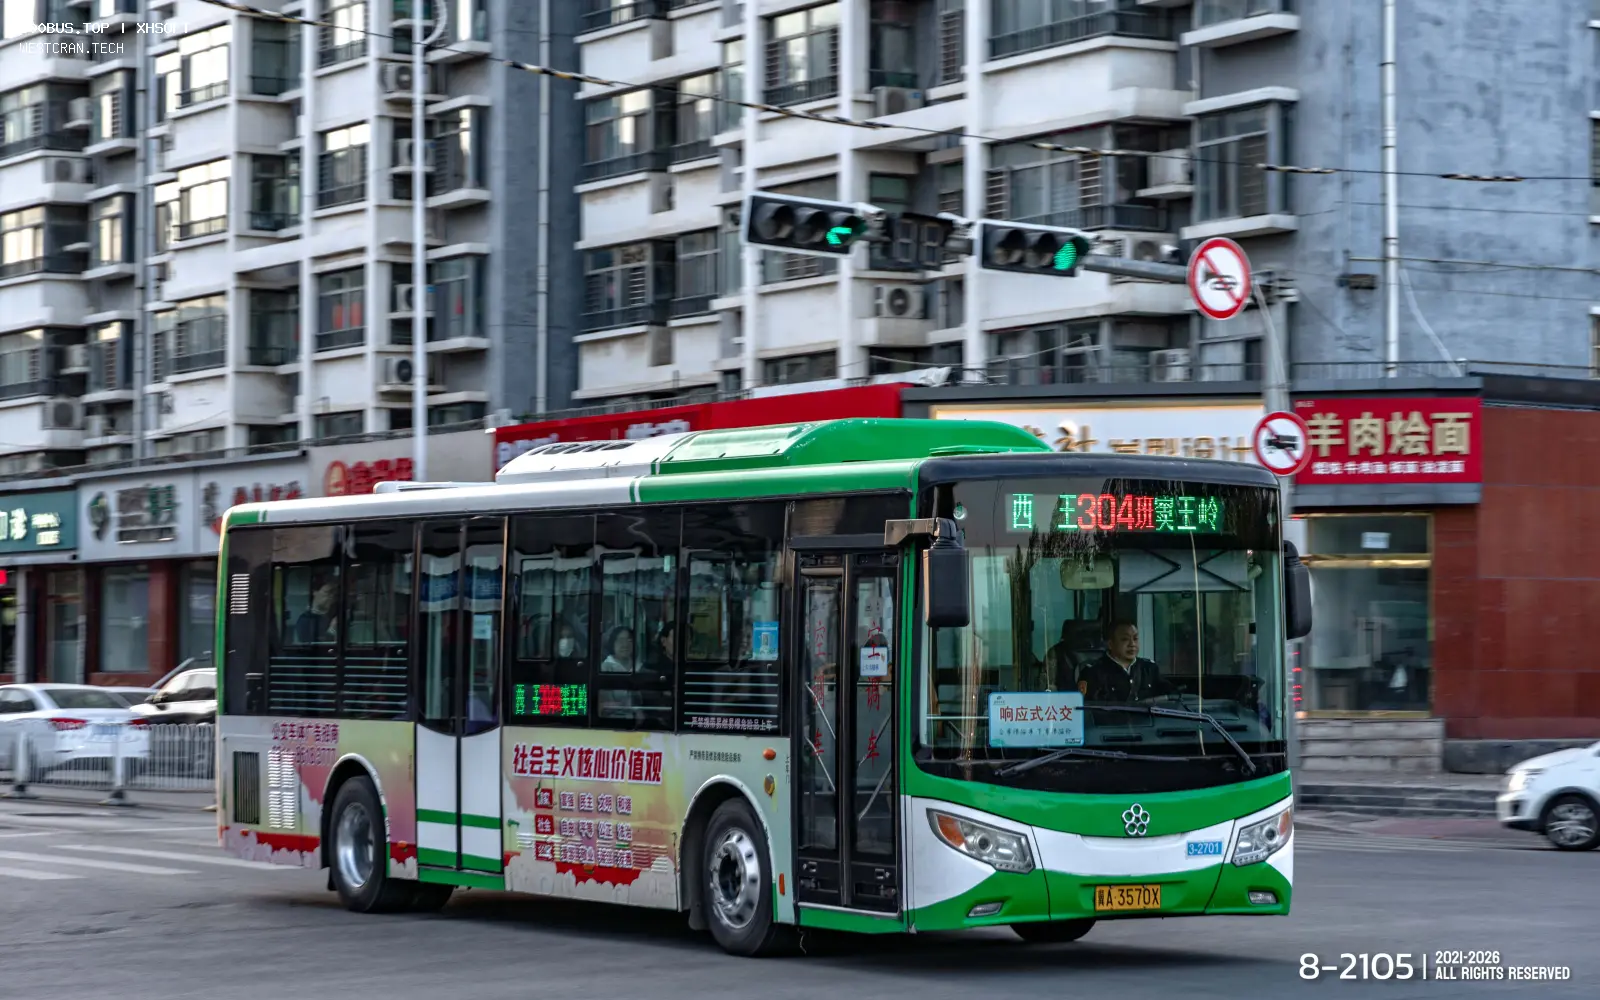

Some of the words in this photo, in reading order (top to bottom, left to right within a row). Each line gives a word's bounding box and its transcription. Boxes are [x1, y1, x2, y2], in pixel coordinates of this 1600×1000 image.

[1307, 411, 1473, 457] 羊肉烩面
[999, 704, 1073, 722] 响应式公交
[512, 743, 663, 783] 社会主义核心价值观
[1188, 841, 1220, 855] 3-2701
